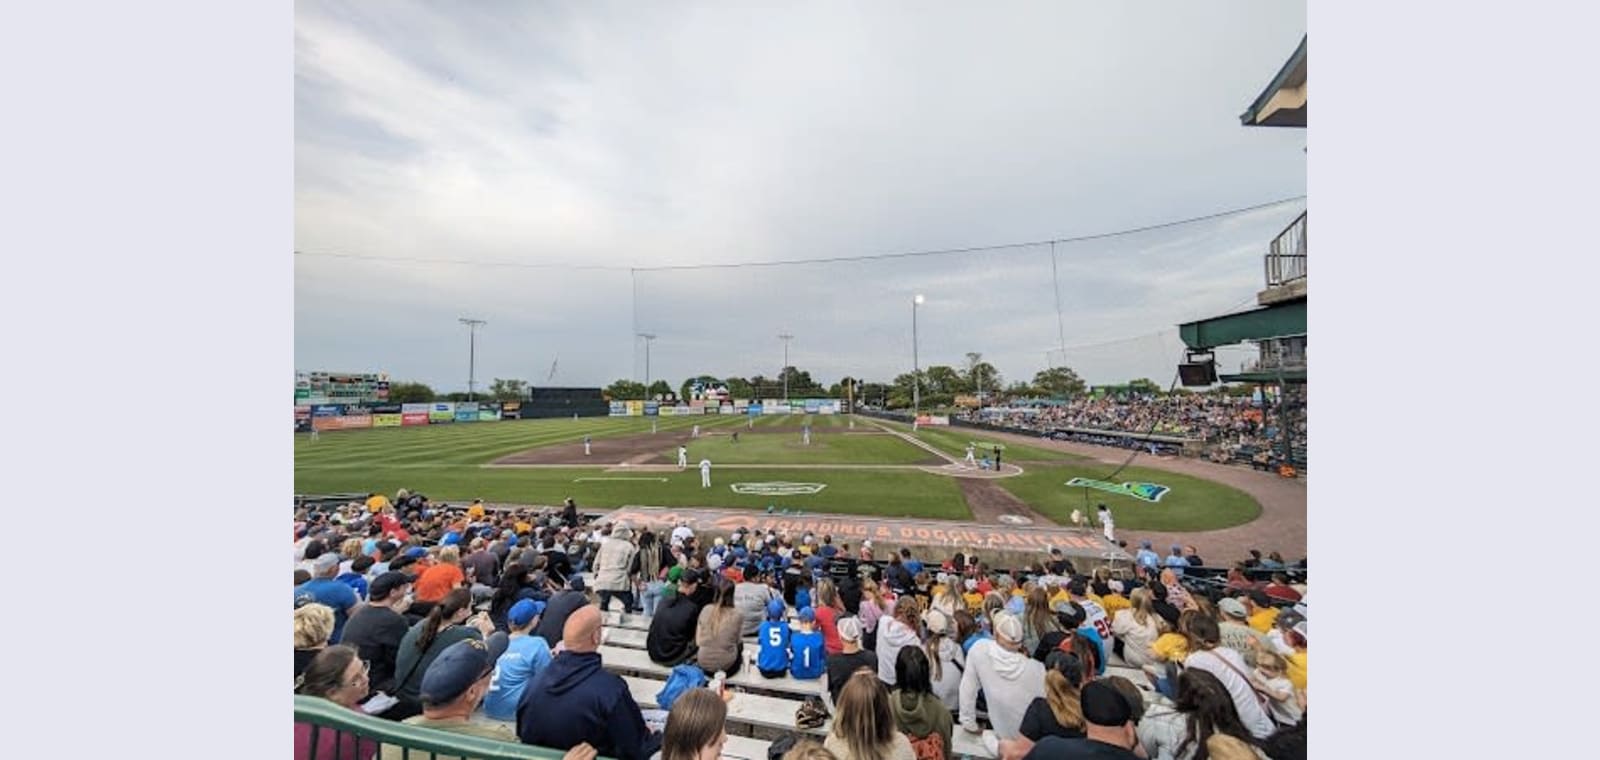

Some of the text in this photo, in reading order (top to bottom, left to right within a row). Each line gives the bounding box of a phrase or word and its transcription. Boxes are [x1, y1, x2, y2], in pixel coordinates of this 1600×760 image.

[763, 519, 868, 536] BOARDING
[876, 525, 892, 536] &
[990, 531, 1101, 549] DAYCARE
[769, 627, 782, 647] 5
[803, 646, 811, 668] 1
